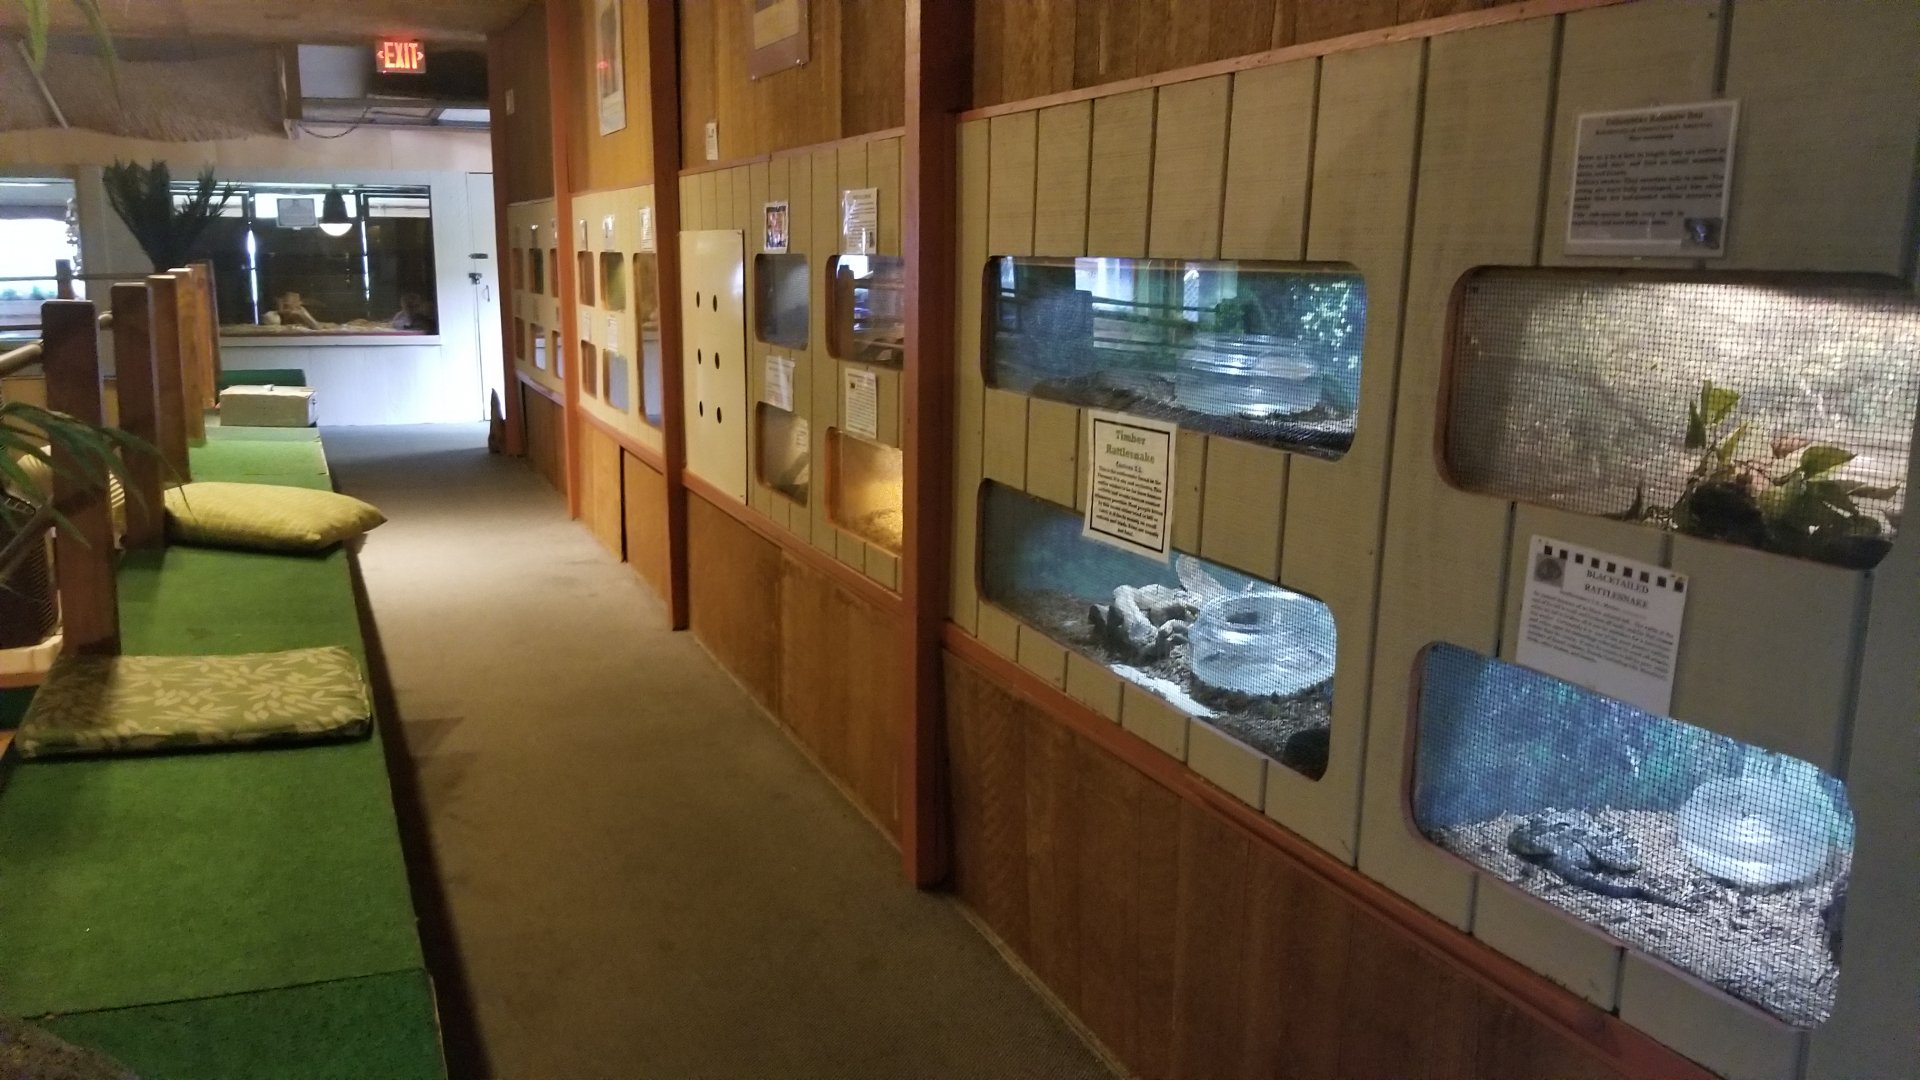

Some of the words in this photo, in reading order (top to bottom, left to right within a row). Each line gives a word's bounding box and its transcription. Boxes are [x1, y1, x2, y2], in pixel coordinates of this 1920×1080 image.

[384, 41, 418, 69] EXIT
[1116, 429, 1146, 445] Timber
[1106, 443, 1155, 464] Rattlesnake
[1586, 569, 1650, 594] BLACKTAILED
[1584, 583, 1649, 609] RATTLESNAKE
